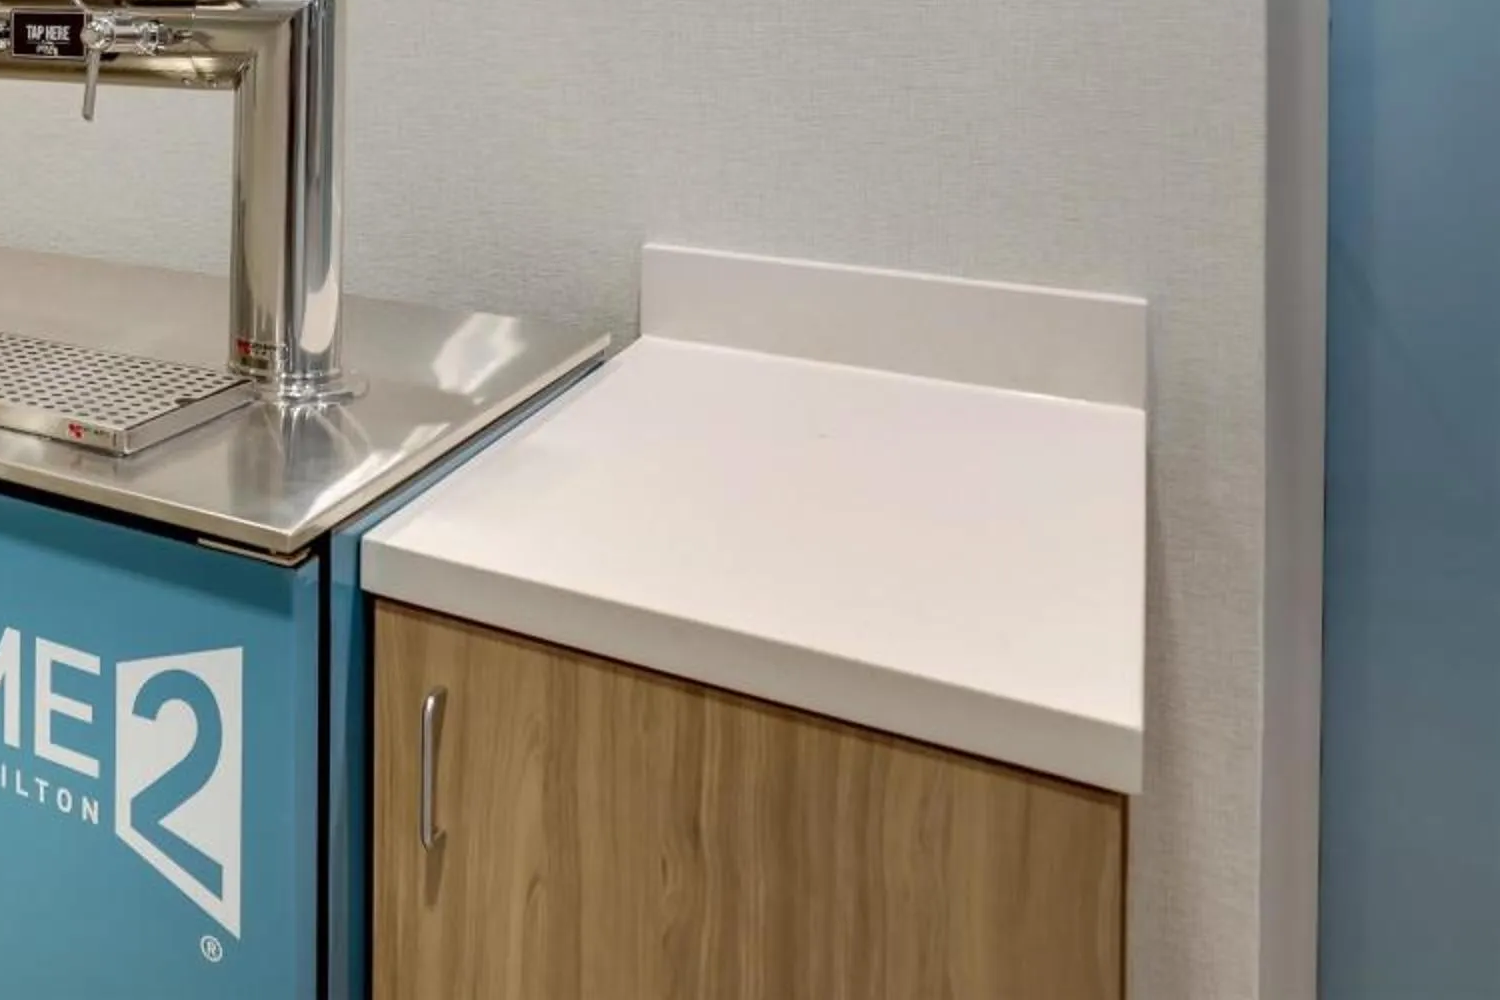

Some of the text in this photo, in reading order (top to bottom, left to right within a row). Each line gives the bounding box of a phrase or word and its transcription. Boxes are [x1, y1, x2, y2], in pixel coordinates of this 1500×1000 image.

[26, 24, 71, 41] TAP HERE
[131, 667, 224, 901] 2
